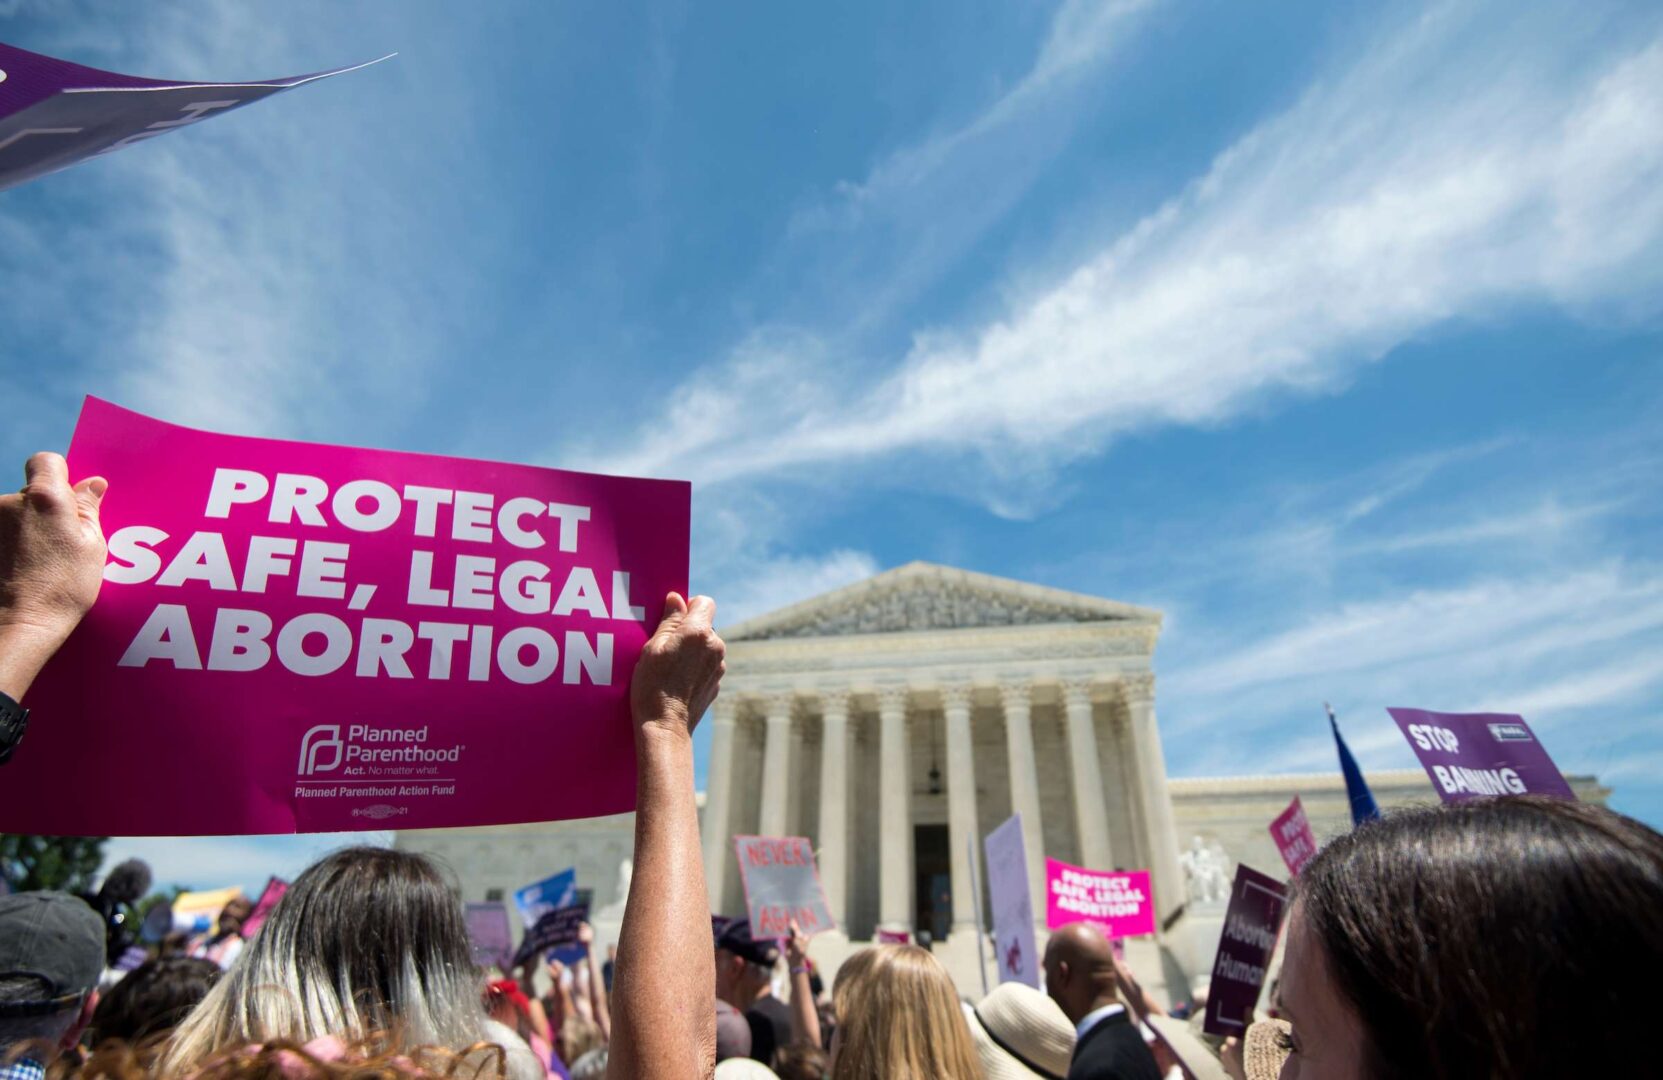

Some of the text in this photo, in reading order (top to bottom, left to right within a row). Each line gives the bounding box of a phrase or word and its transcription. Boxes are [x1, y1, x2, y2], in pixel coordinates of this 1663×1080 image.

[205, 467, 591, 554] PROTECT
[104, 525, 645, 621] SAFE, LEGAL
[118, 603, 614, 686] ABORTION
[348, 724, 428, 743] Planned
[1408, 724, 1459, 754] STOP
[346, 745, 460, 762] Parenthood
[344, 765, 440, 776] Act. No matter what.
[1432, 764, 1527, 796] BANNING
[295, 785, 455, 798] Planned Parenthood Action Fund
[745, 839, 807, 867] NEVER
[1062, 869, 1131, 890] PROTECT
[1094, 887, 1146, 903] LEGAL
[1057, 896, 1140, 918] ABORTION
